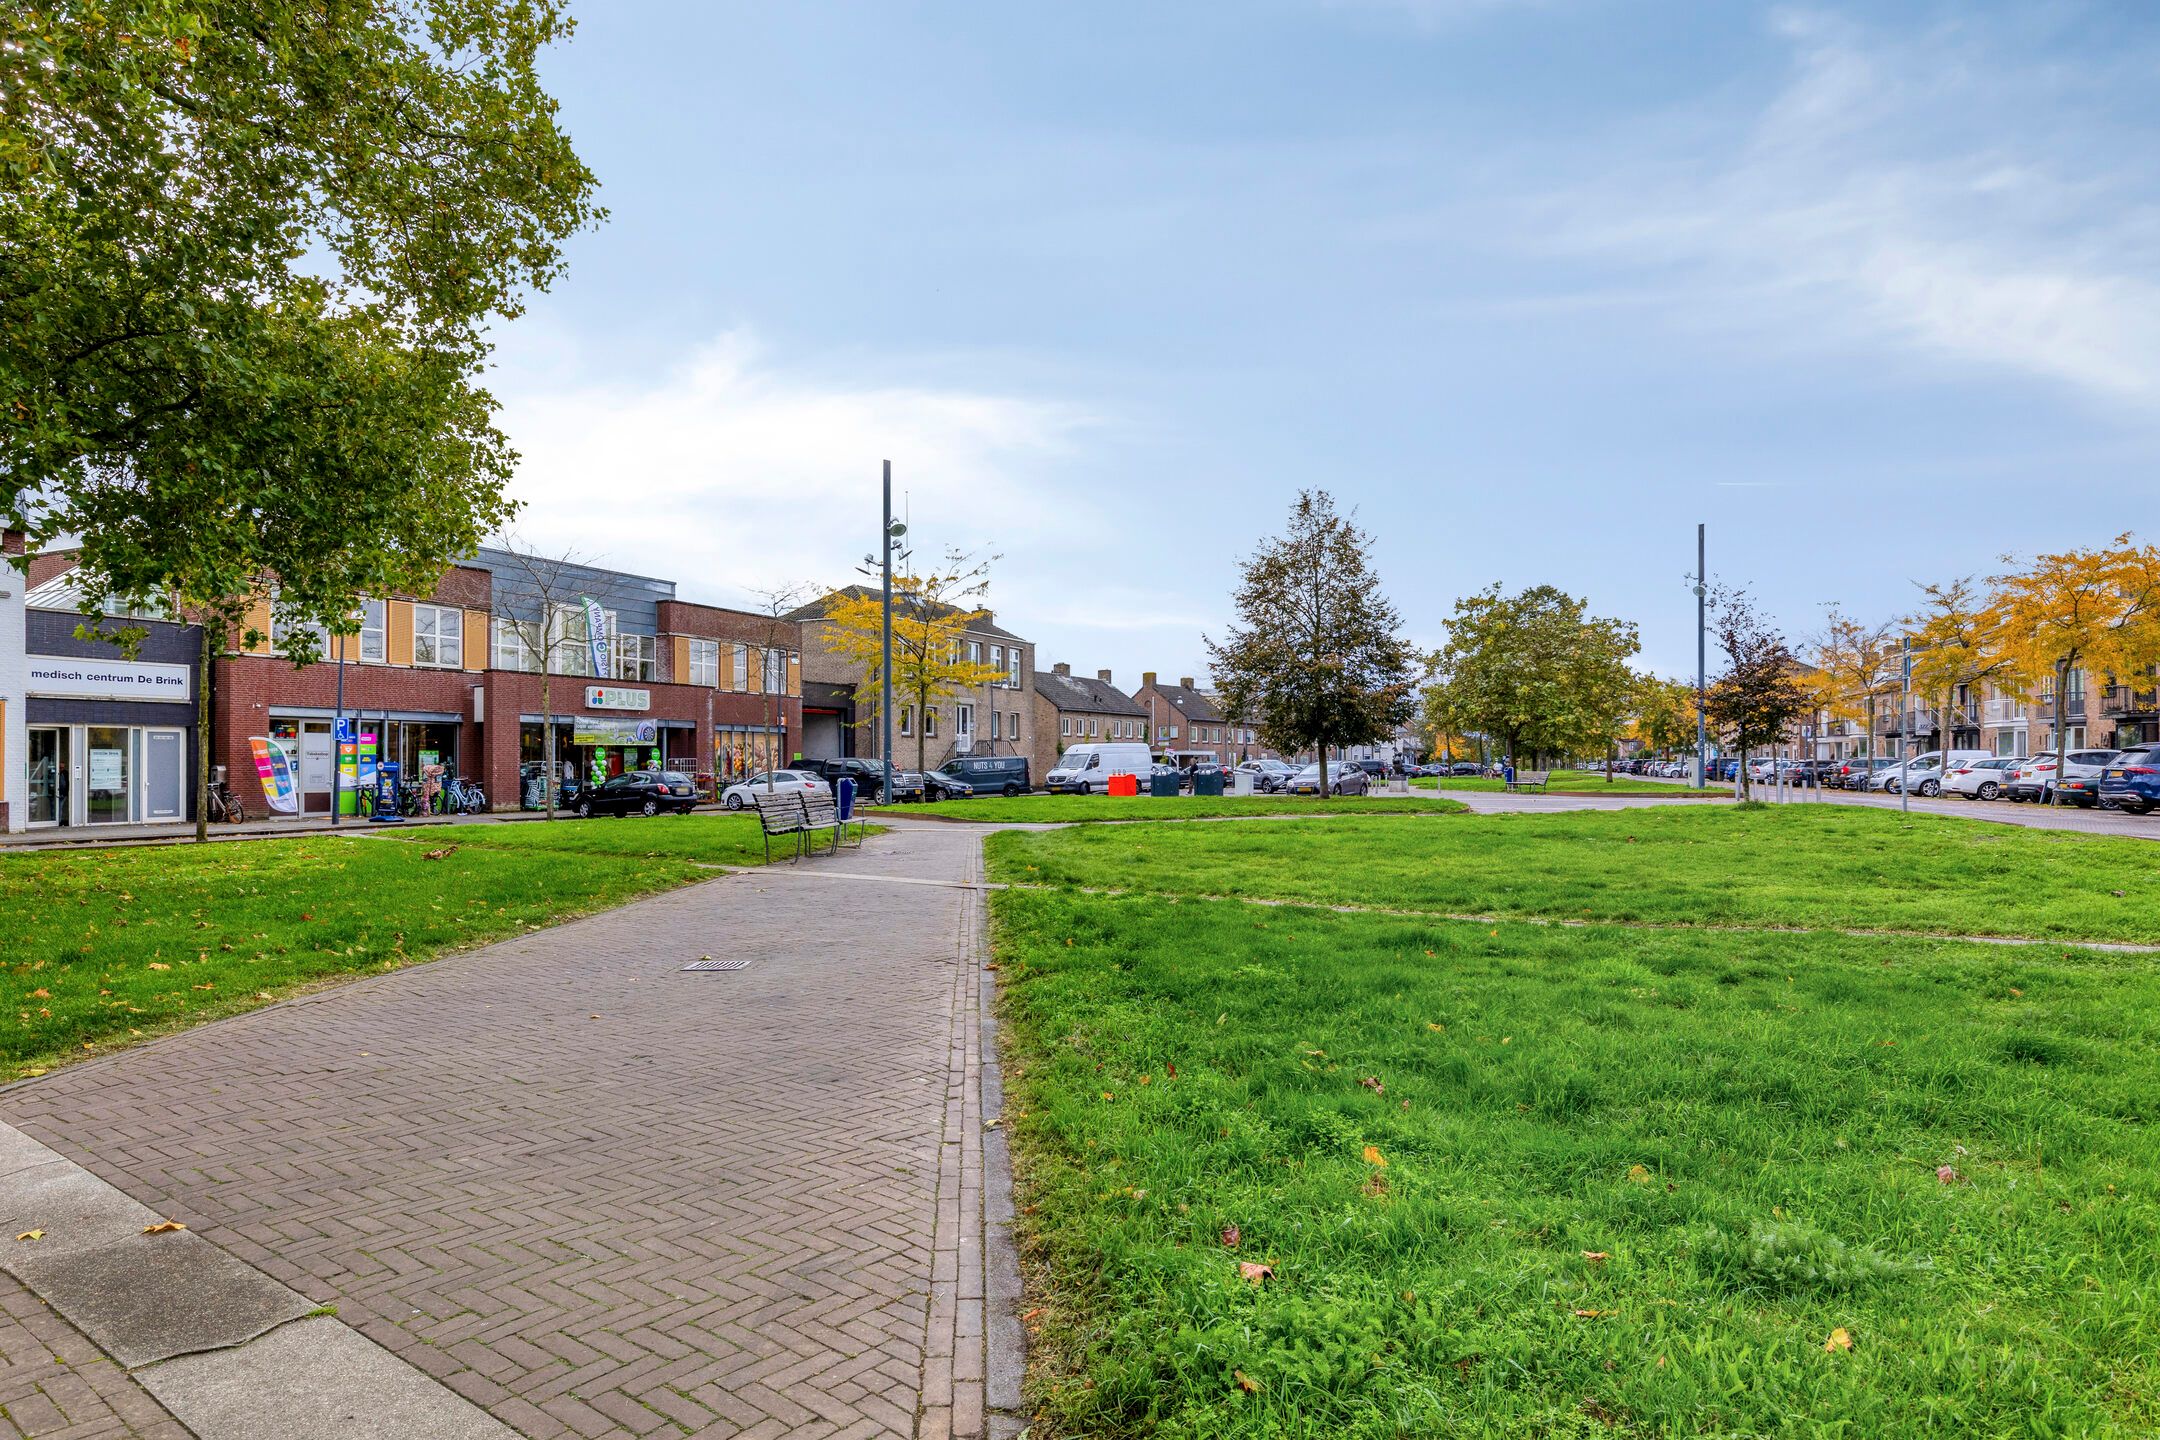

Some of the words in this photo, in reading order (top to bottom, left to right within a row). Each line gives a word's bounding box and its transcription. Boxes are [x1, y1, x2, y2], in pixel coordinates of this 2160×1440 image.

[31, 670, 82, 680] medisch
[86, 673, 134, 683] centrum
[137, 675, 153, 684] De
[155, 676, 184, 686] Brink
[605, 690, 648, 707] PLUS
[337, 720, 346, 731] P
[973, 761, 988, 770] NUTS
[994, 761, 1006, 769] YOU
